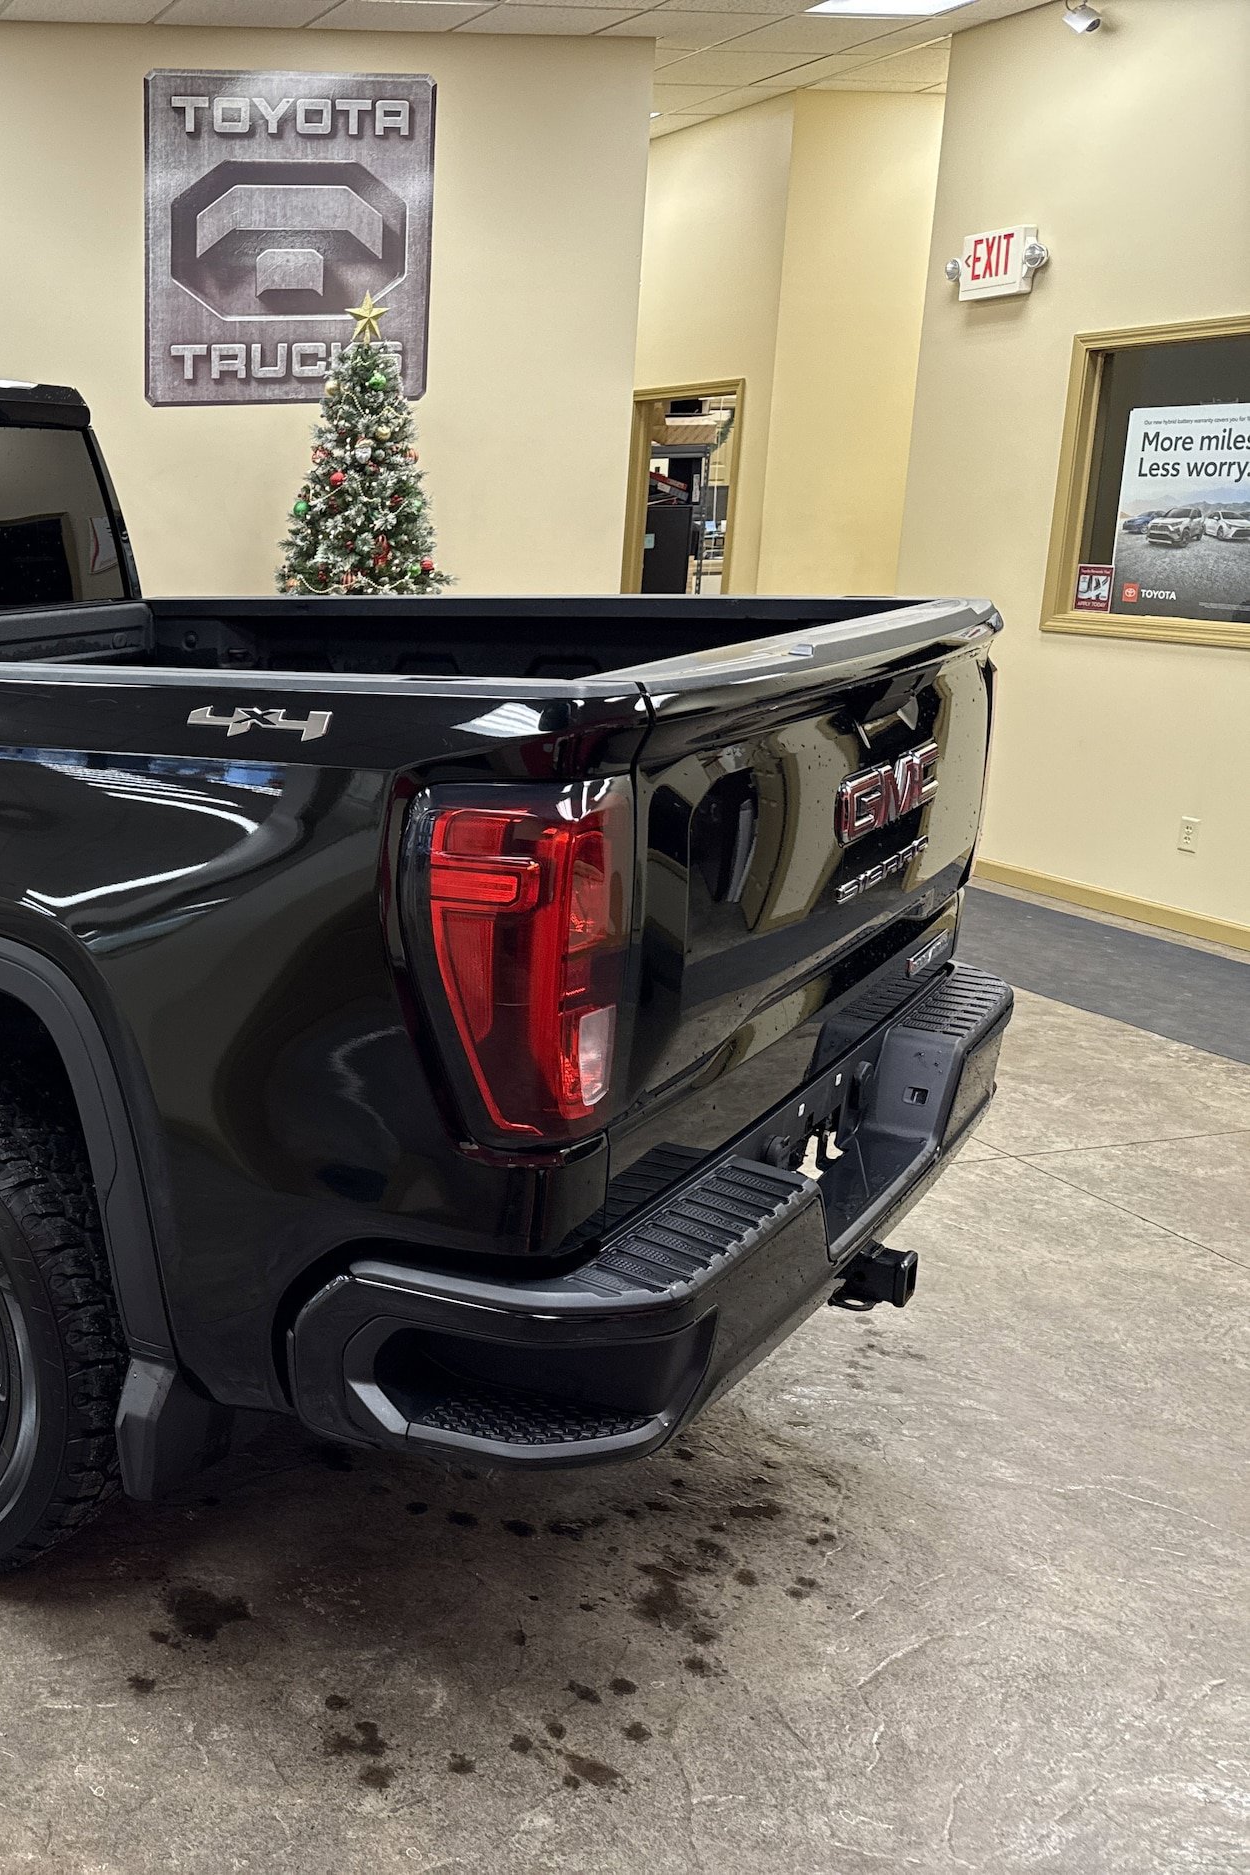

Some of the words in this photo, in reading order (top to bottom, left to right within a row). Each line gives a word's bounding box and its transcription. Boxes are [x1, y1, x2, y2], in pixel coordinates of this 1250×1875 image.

[171, 97, 410, 135] TOYOTA
[971, 233, 1014, 280] EXIT
[1141, 431, 1194, 452] More
[1138, 457, 1181, 477] Less
[1141, 589, 1177, 600] TOYOTA
[834, 743, 939, 848] GMC
[836, 835, 929, 904] SIERRA
